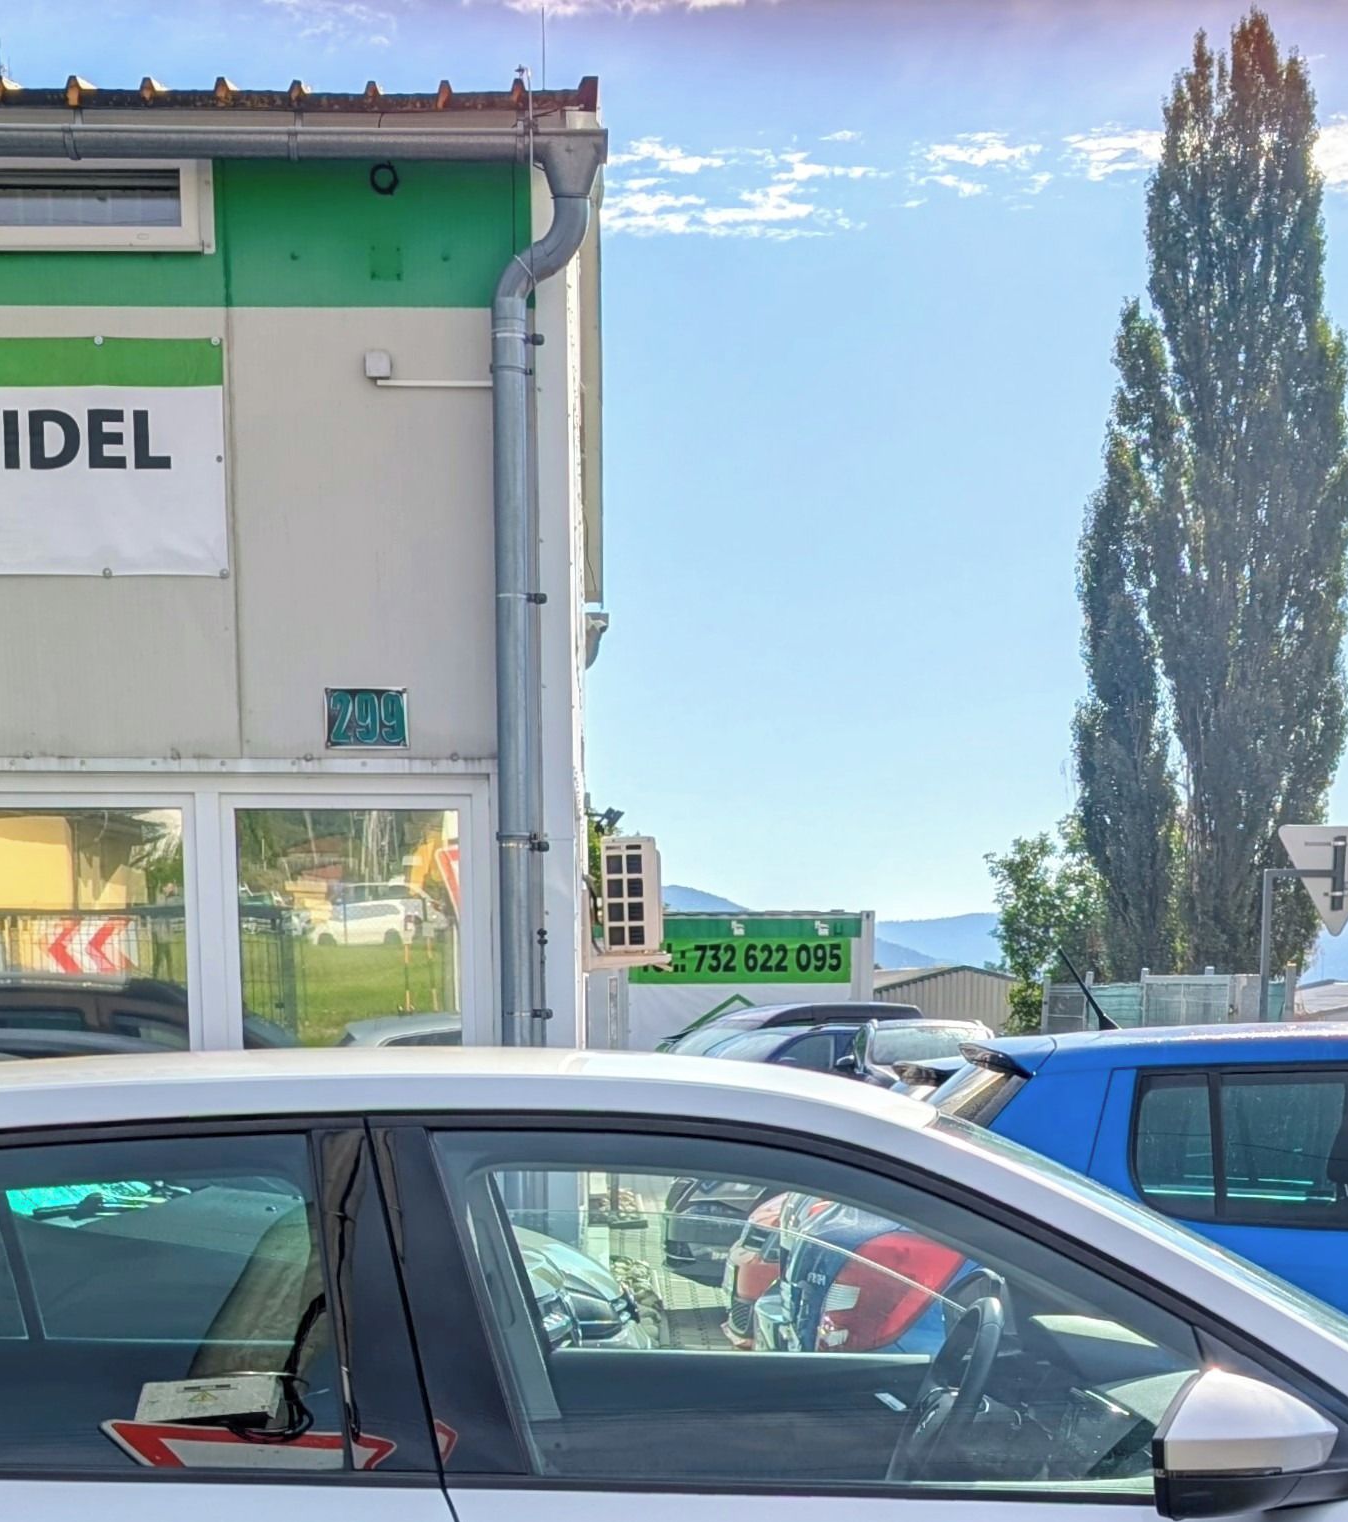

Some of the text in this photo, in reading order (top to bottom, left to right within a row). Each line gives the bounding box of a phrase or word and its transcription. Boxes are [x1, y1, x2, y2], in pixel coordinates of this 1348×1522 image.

[330, 691, 406, 743] 299
[693, 943, 737, 973] 732
[744, 943, 788, 973] 622
[795, 943, 842, 973] 095
